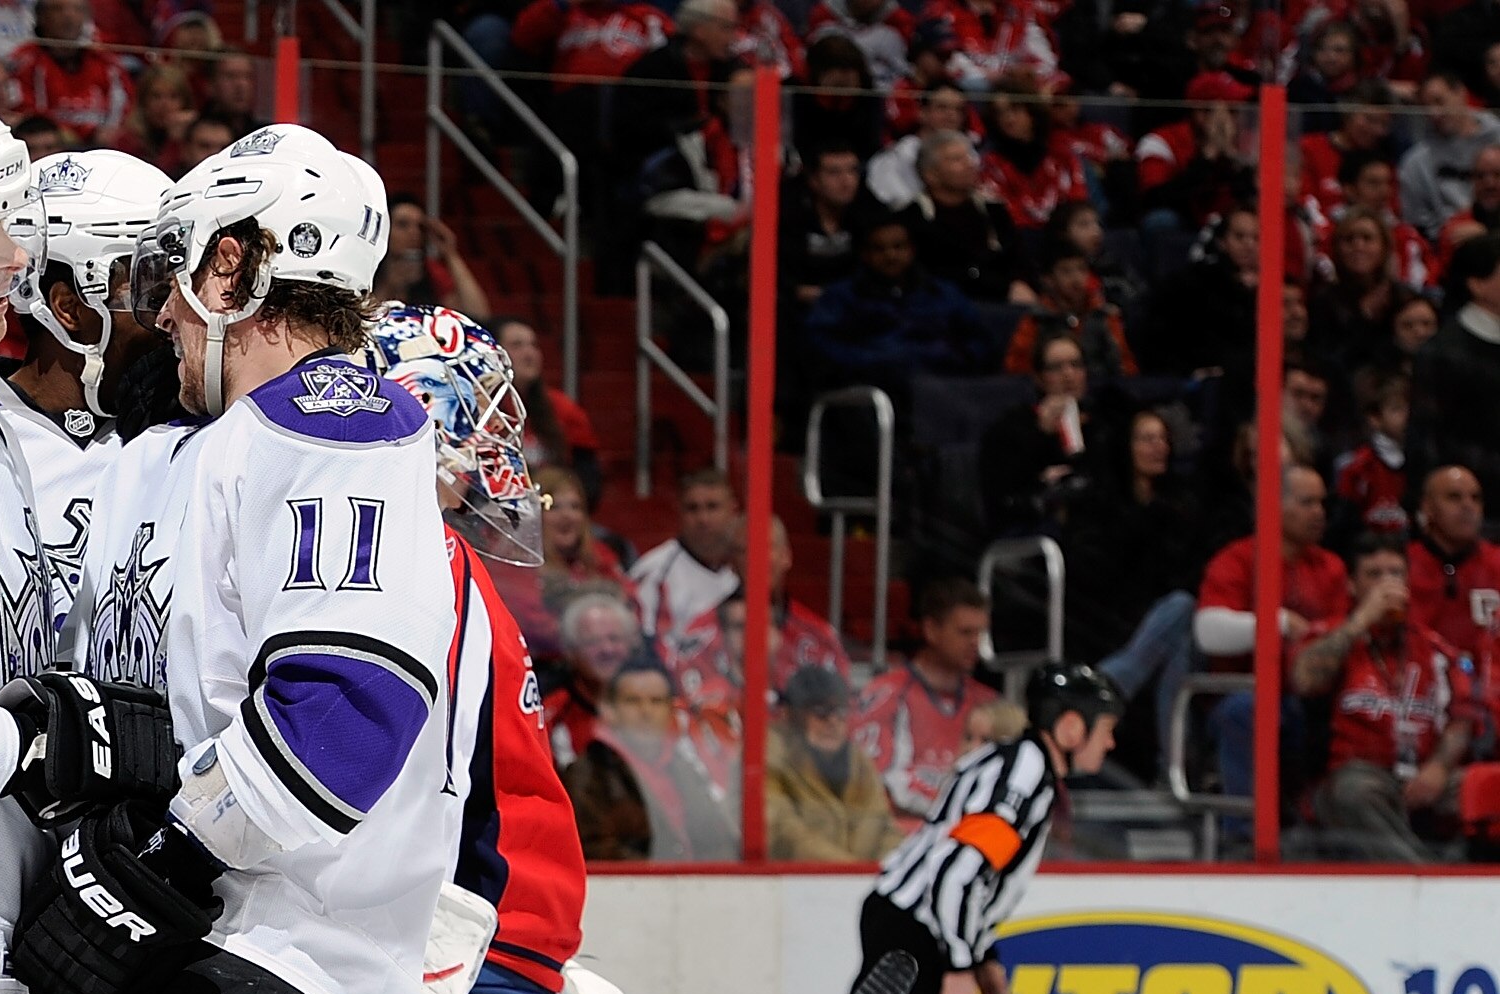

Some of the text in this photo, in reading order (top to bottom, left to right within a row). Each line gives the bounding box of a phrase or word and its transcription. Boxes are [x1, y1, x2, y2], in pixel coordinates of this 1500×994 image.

[357, 204, 383, 246] 11
[282, 496, 384, 592] 11
[69, 676, 112, 779] EAS
[61, 828, 157, 942] AUER
